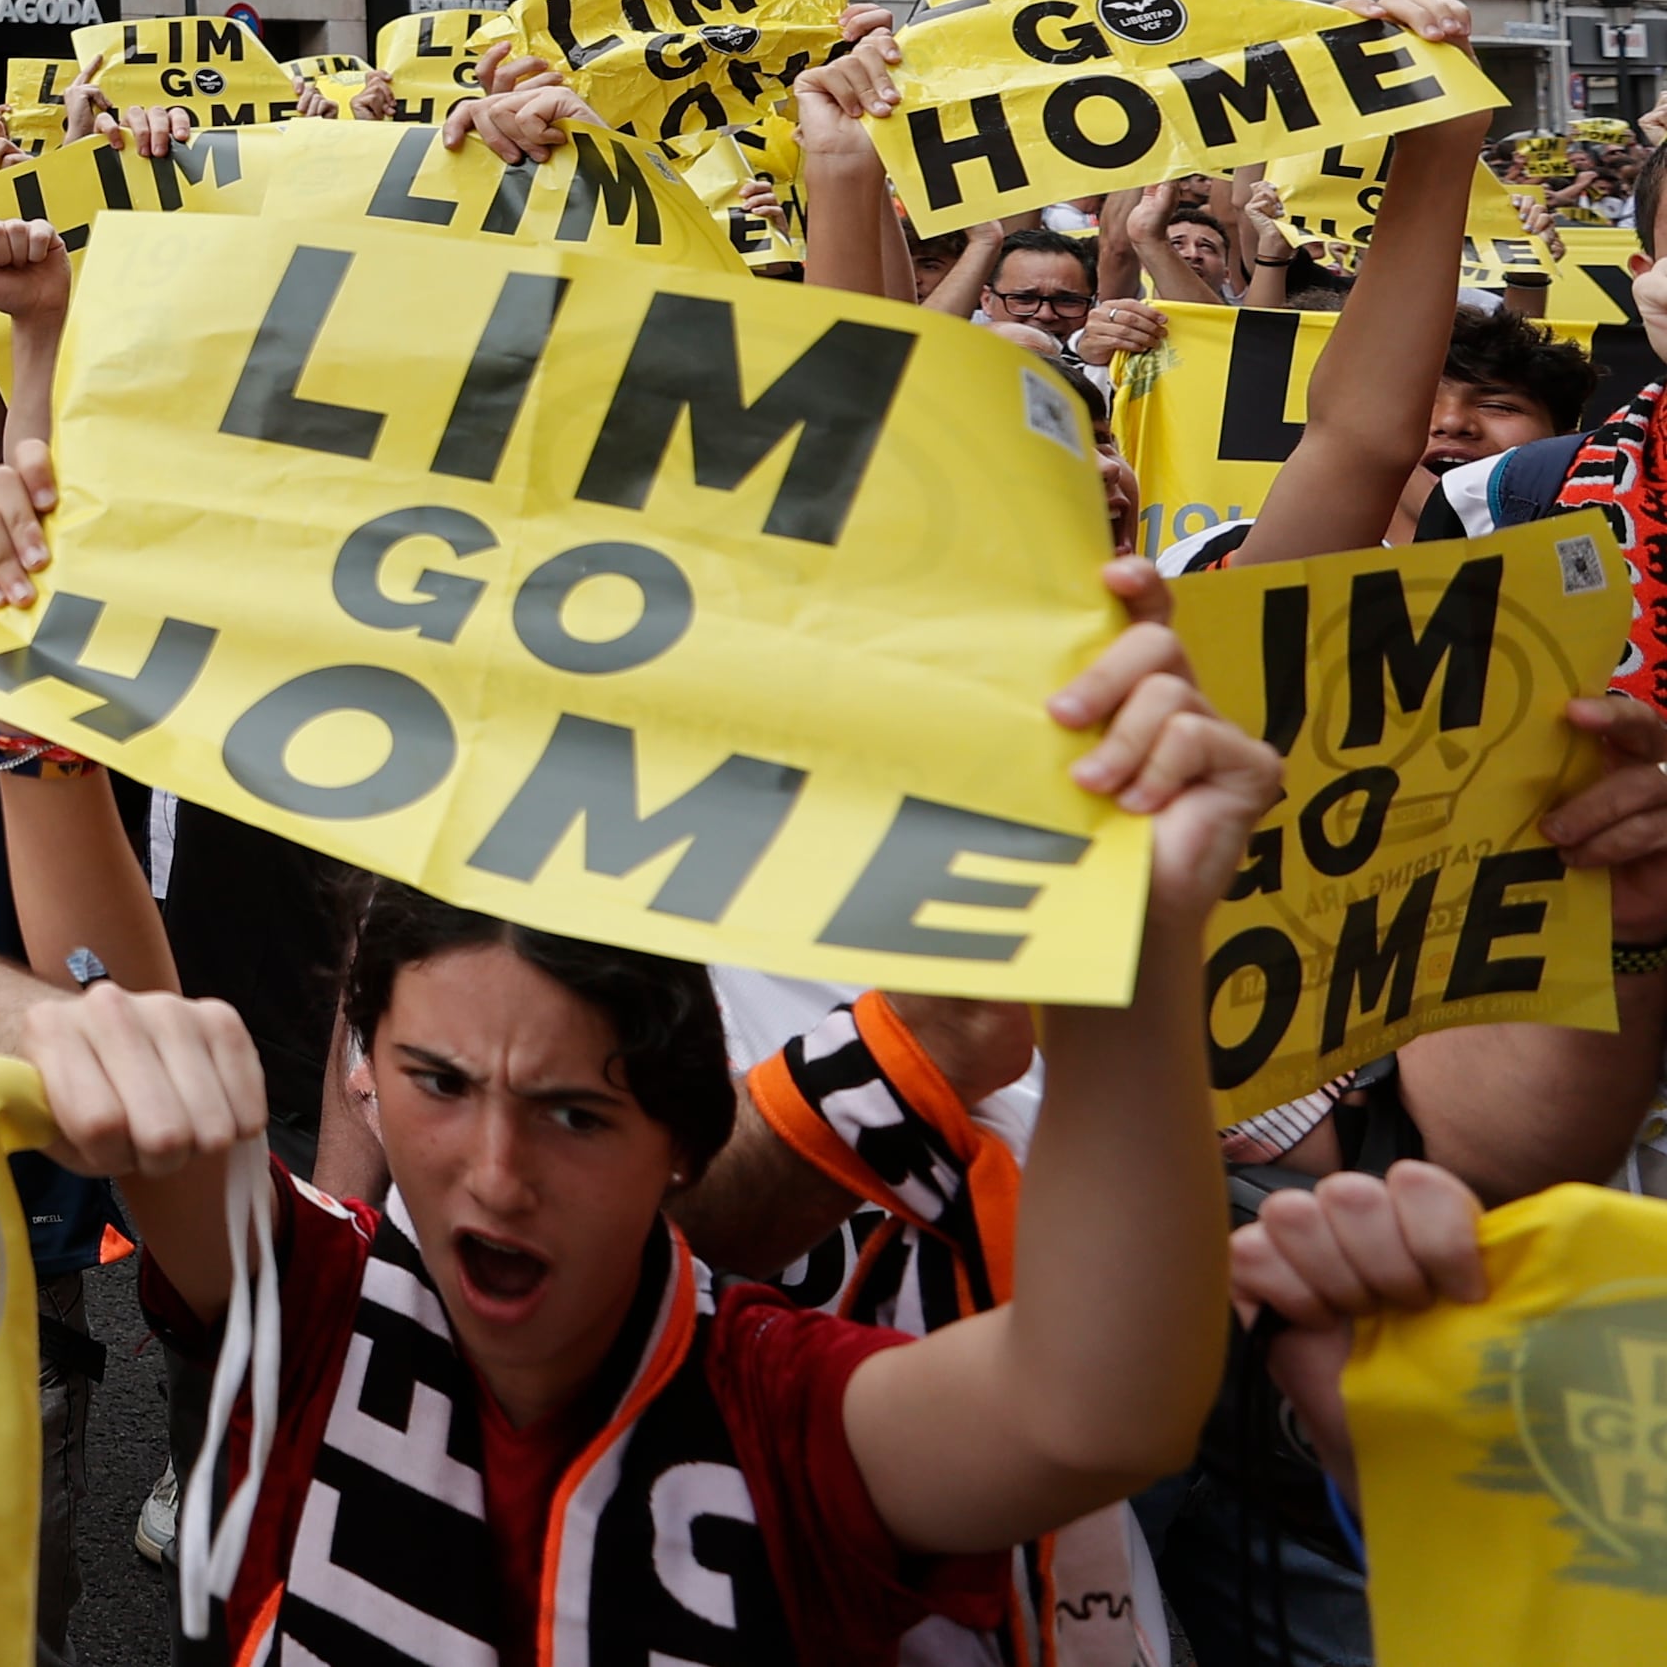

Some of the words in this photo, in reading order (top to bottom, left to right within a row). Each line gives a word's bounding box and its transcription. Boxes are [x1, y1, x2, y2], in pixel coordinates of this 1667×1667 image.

[123, 20, 244, 64] LIM
[417, 14, 482, 58] LI
[1119, 8, 1175, 28] LIBERTAD
[1137, 20, 1163, 32] VCF
[907, 18, 1445, 211] HOME
[1320, 135, 1395, 182] LI
[1529, 160, 1572, 174] HOME
[13, 128, 243, 251] LIM
[366, 127, 662, 245] LIM
[218, 246, 920, 546] LIM
[332, 505, 696, 675] GO
[1263, 555, 1504, 758] IM
[1205, 848, 1567, 1090] OME
